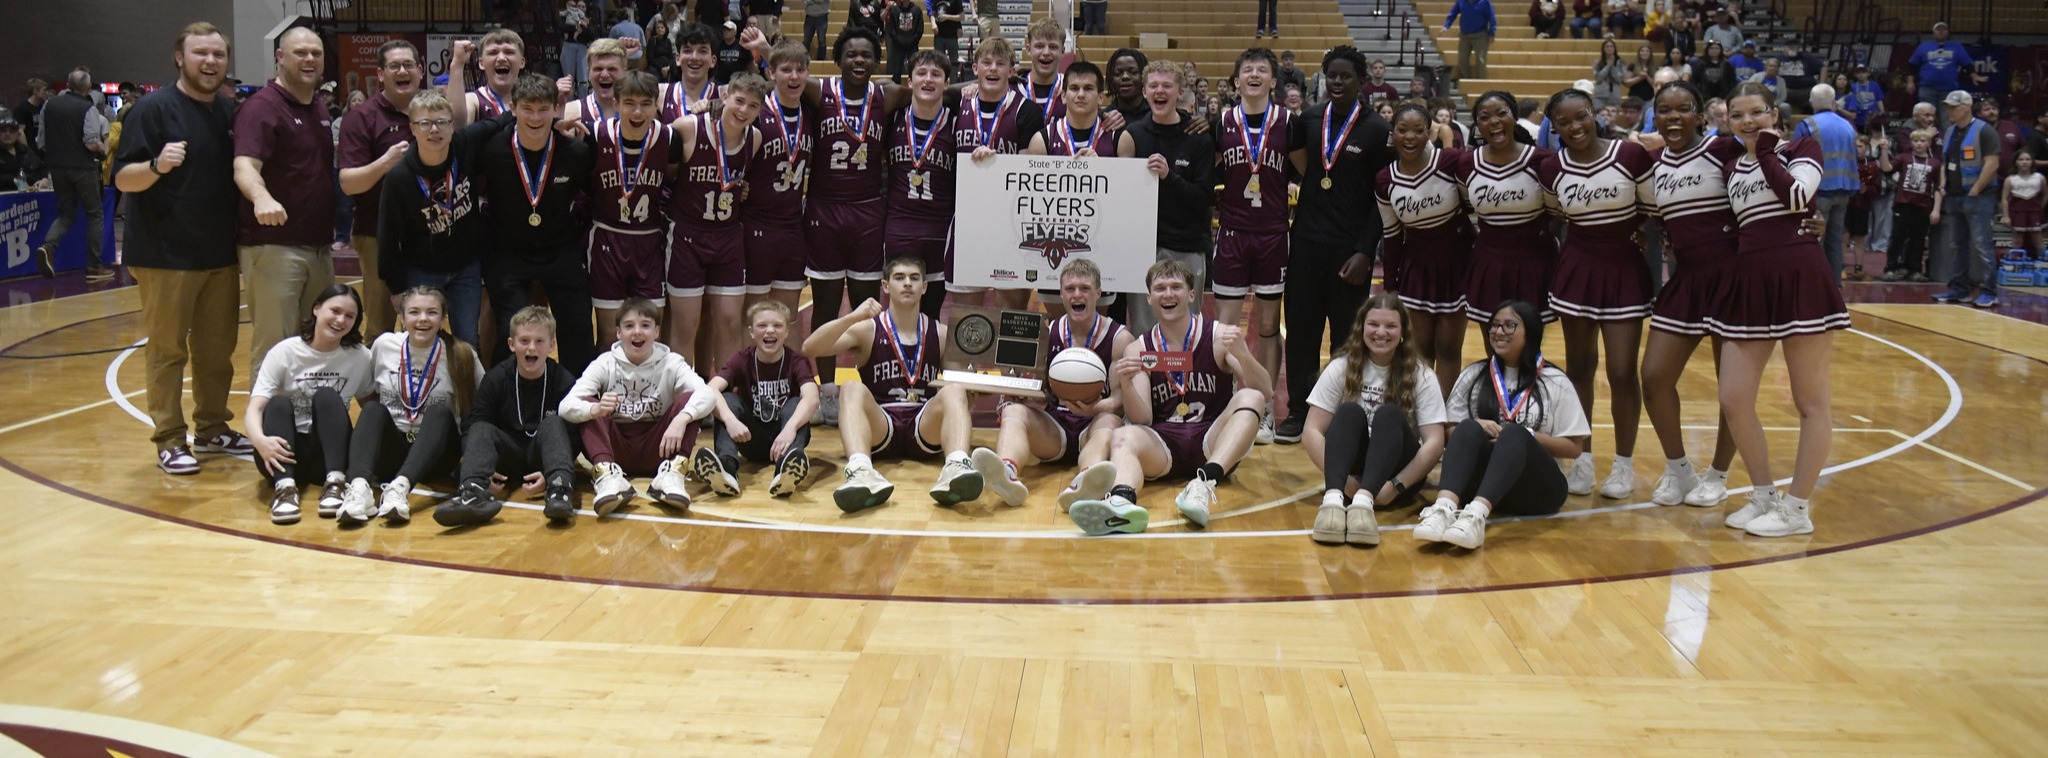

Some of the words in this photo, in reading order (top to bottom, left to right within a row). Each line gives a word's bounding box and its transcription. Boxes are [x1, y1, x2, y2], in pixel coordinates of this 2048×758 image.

[352, 35, 390, 43] SCOOTER'S
[830, 141, 868, 170] 24
[889, 145, 954, 171] FREMAN
[1029, 159, 1050, 169] State
[1052, 160, 1065, 169] "B"
[1066, 160, 1089, 170] 2026
[1223, 146, 1285, 172] FREAN
[600, 167, 664, 189] FREMAN
[773, 160, 806, 192] 34
[907, 170, 933, 200] 11
[1005, 172, 1109, 194] FREEMAN
[1656, 171, 1704, 198] Flyers
[1243, 173, 1262, 207] 4
[1474, 182, 1527, 207] Flyers
[1564, 183, 1620, 208] Flyers
[618, 193, 650, 224] 14
[1017, 196, 1096, 217] FLYERS
[1395, 193, 1443, 217] Flyers
[14, 211, 41, 230] place
[1022, 222, 1090, 244] FLYERS
[873, 360, 937, 384] FREAN
[1152, 372, 1217, 407] FREMAN
[616, 401, 661, 415] REEMAN
